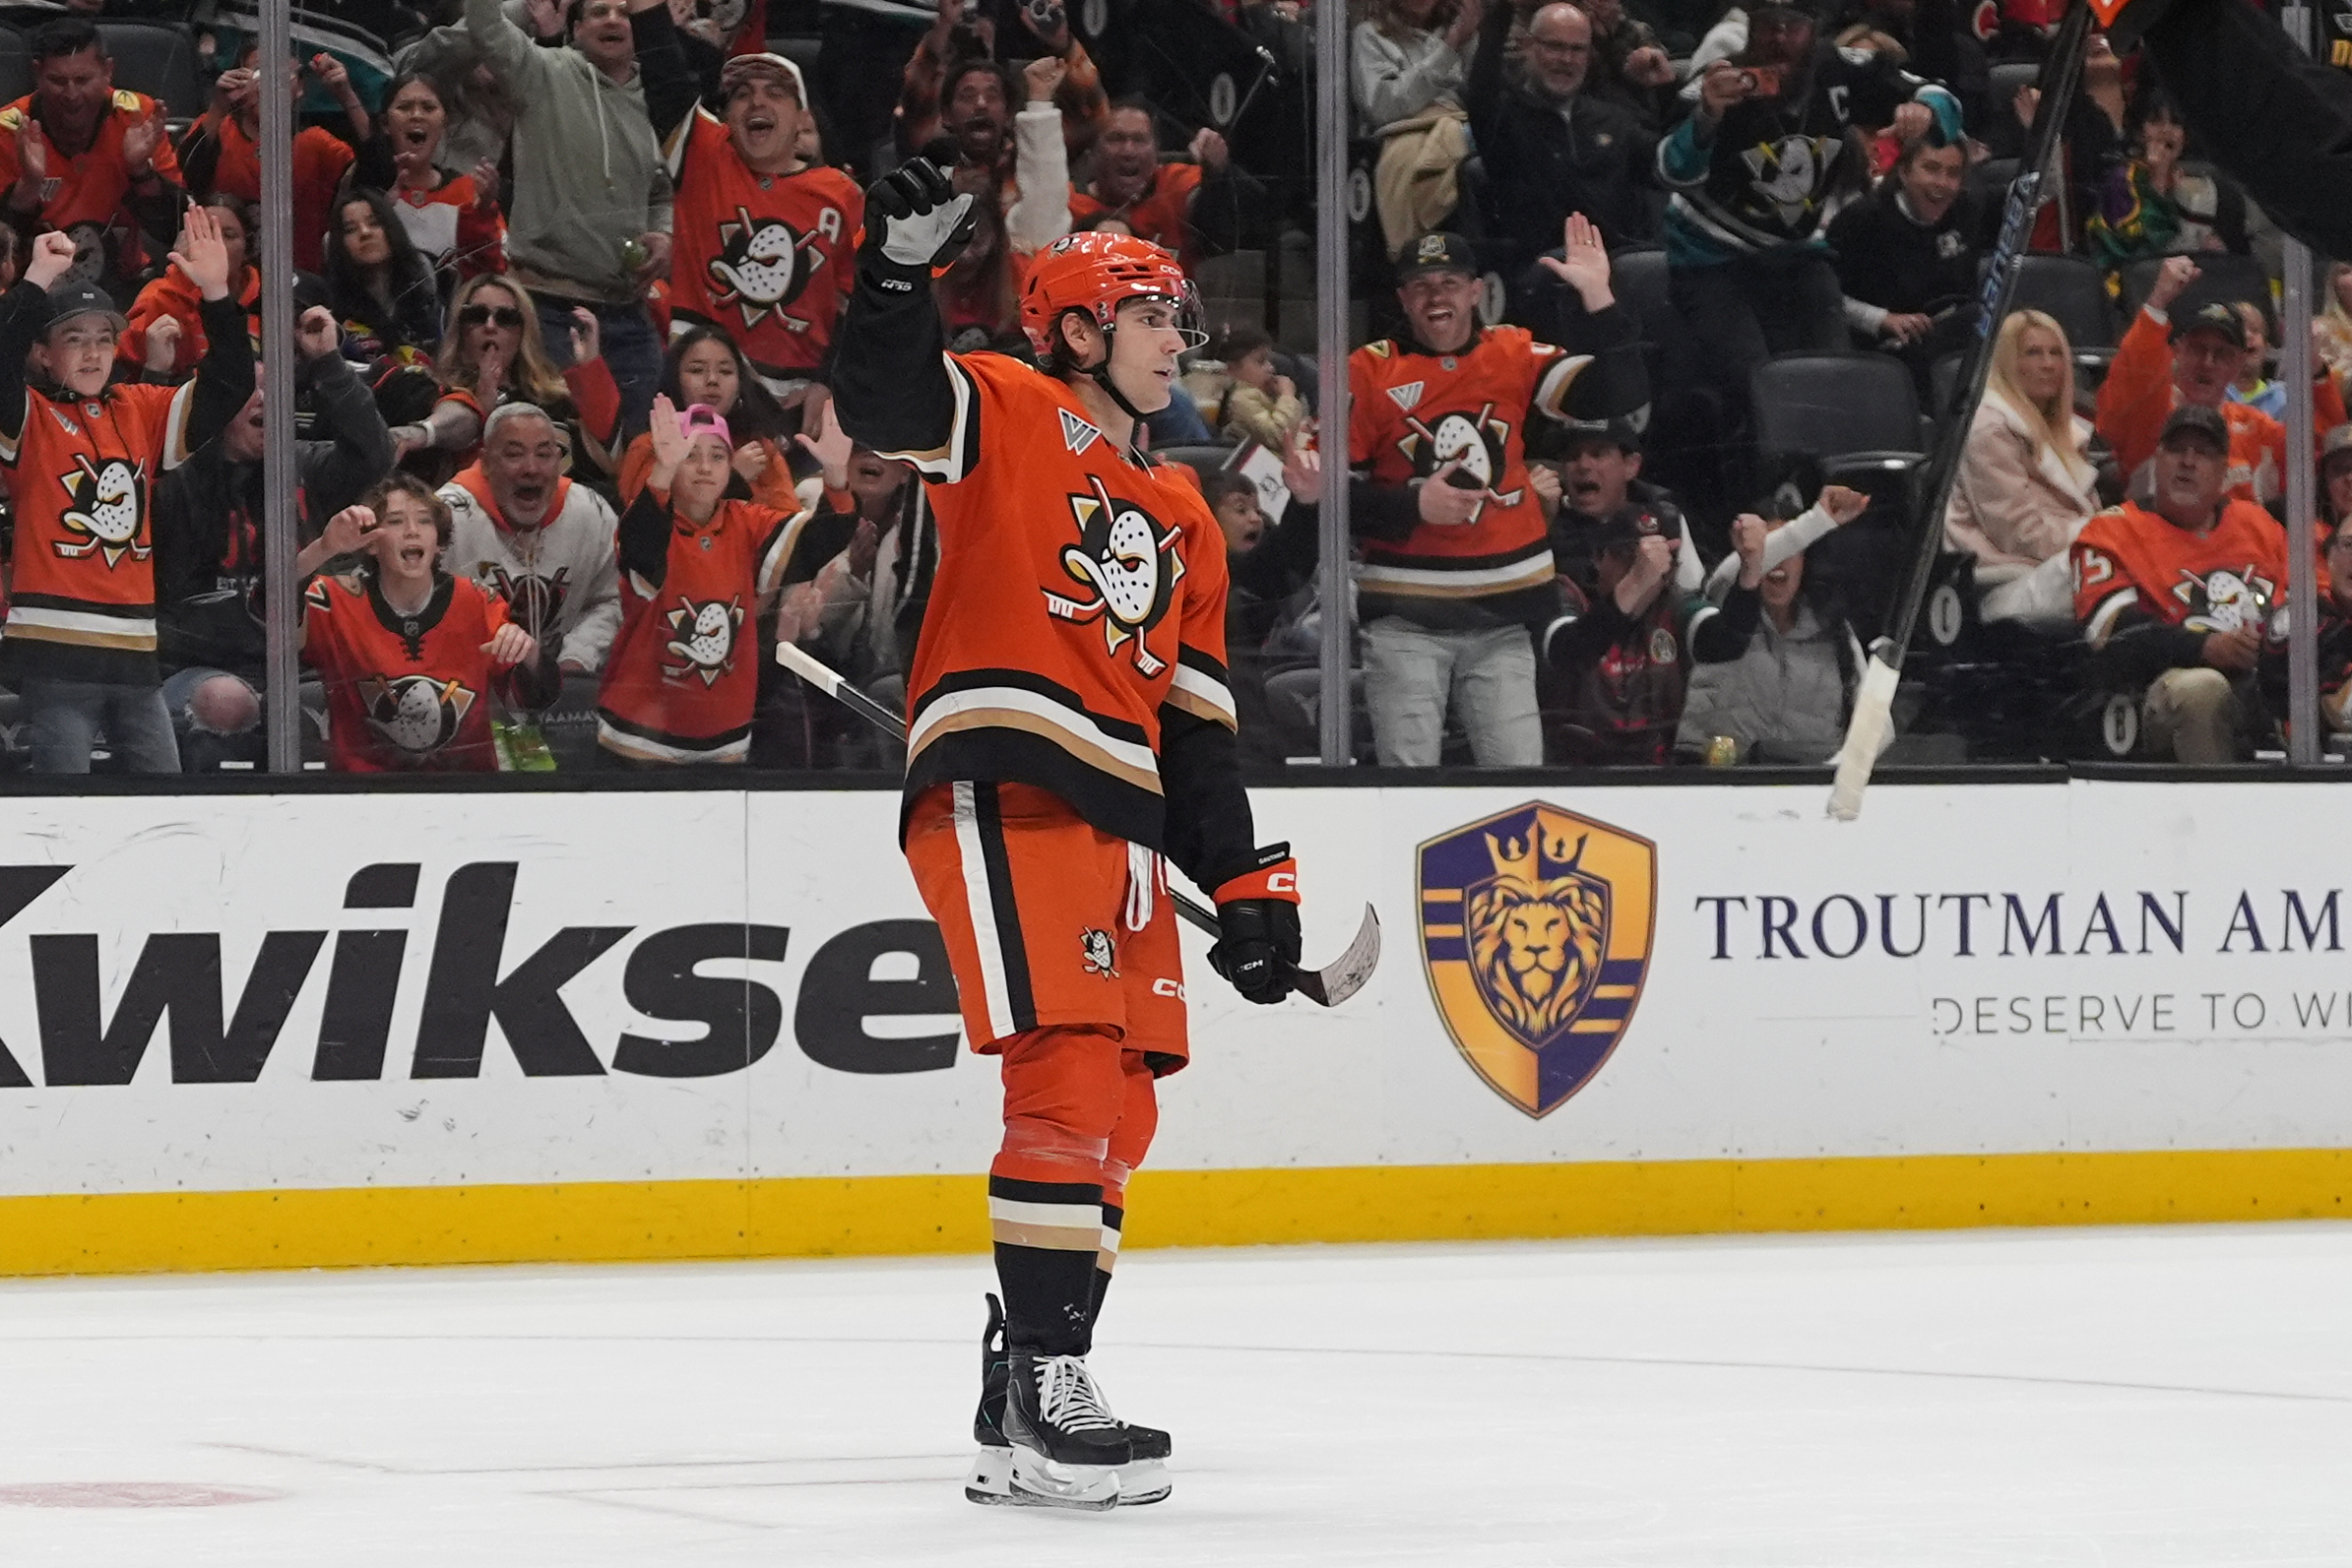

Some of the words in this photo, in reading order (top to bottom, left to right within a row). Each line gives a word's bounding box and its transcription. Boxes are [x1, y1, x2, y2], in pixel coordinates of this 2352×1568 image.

[819, 207, 840, 244] A
[1694, 890, 2190, 960] TROUTMAN
[2217, 888, 2346, 953] AM
[1933, 993, 2175, 1035] DESERVE
[2201, 992, 2265, 1030] TO
